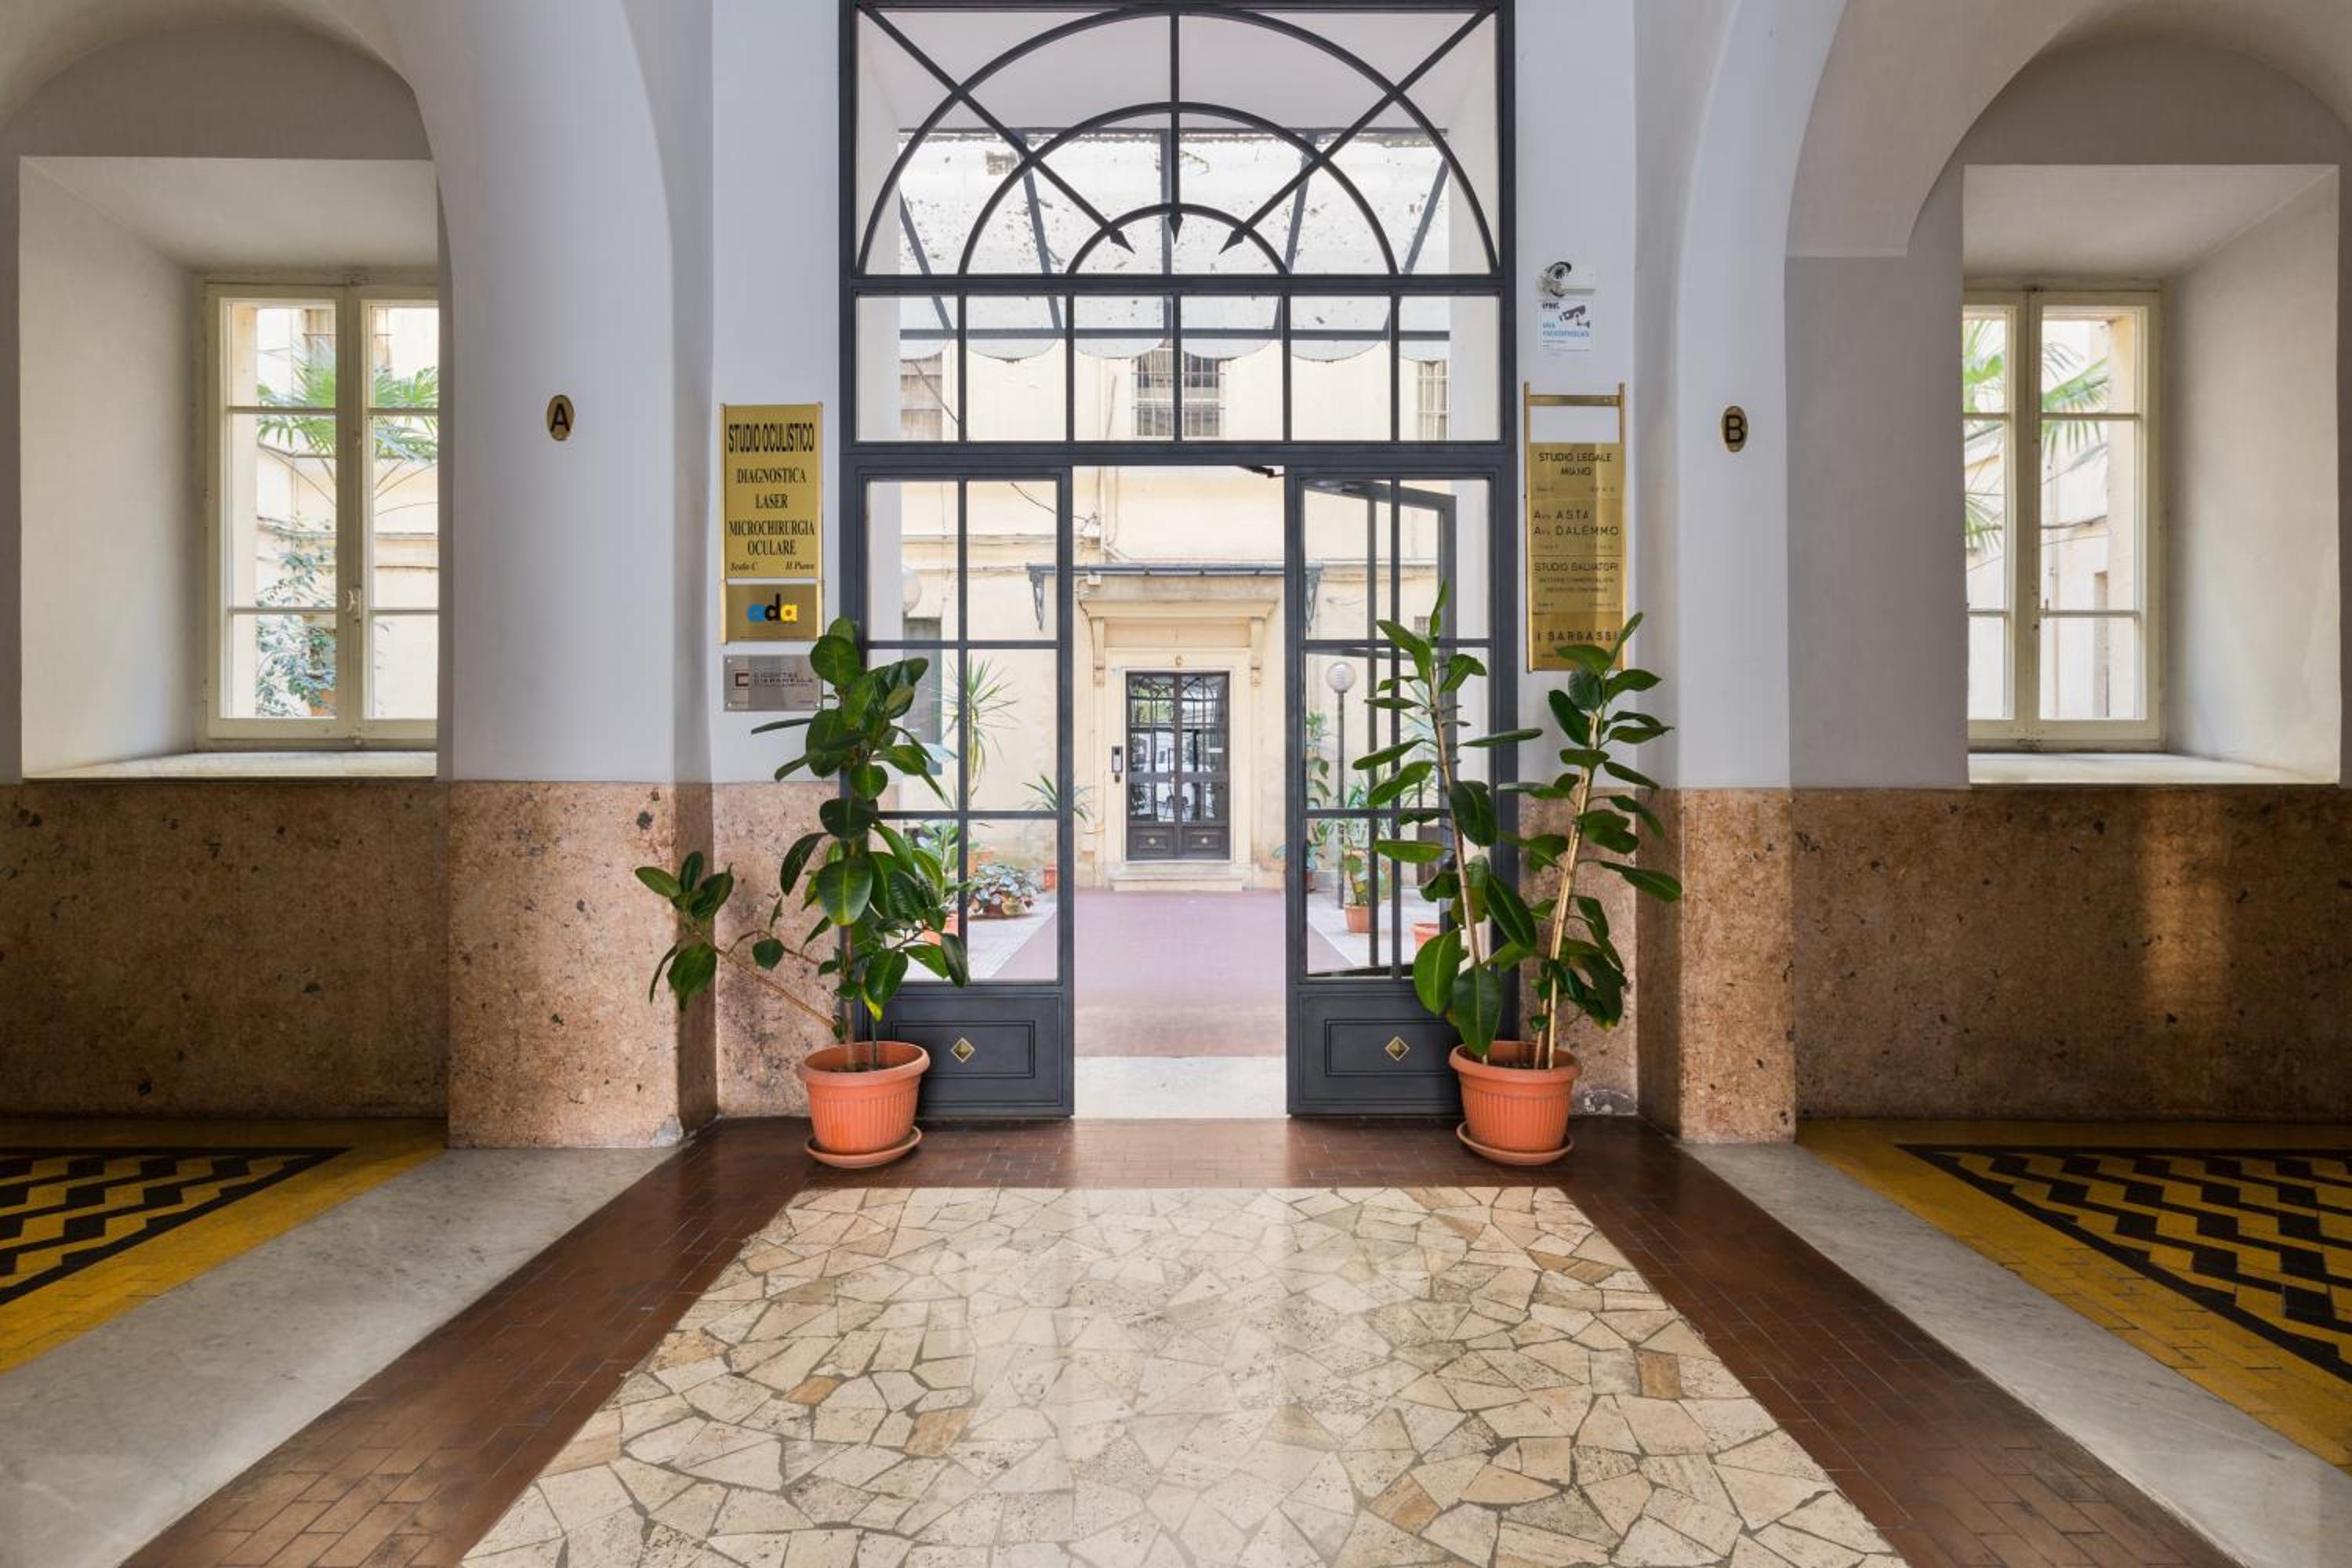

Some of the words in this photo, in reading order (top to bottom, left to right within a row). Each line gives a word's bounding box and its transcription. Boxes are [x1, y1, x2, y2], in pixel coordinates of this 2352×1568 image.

[551, 403, 570, 431] A
[1726, 414, 1744, 443] B
[728, 423, 760, 452] STUDIO
[763, 423, 815, 452] OCULISTICO
[1539, 452, 1573, 463] STUDIO
[1577, 452, 1612, 463] LEGALE
[737, 468, 807, 484] DIAGNOSTICA
[755, 493, 788, 509] LASER
[729, 520, 815, 536] MICROCHIRURGIA
[747, 539, 796, 556] OCULARE
[1534, 562, 1567, 572] STUDIO
